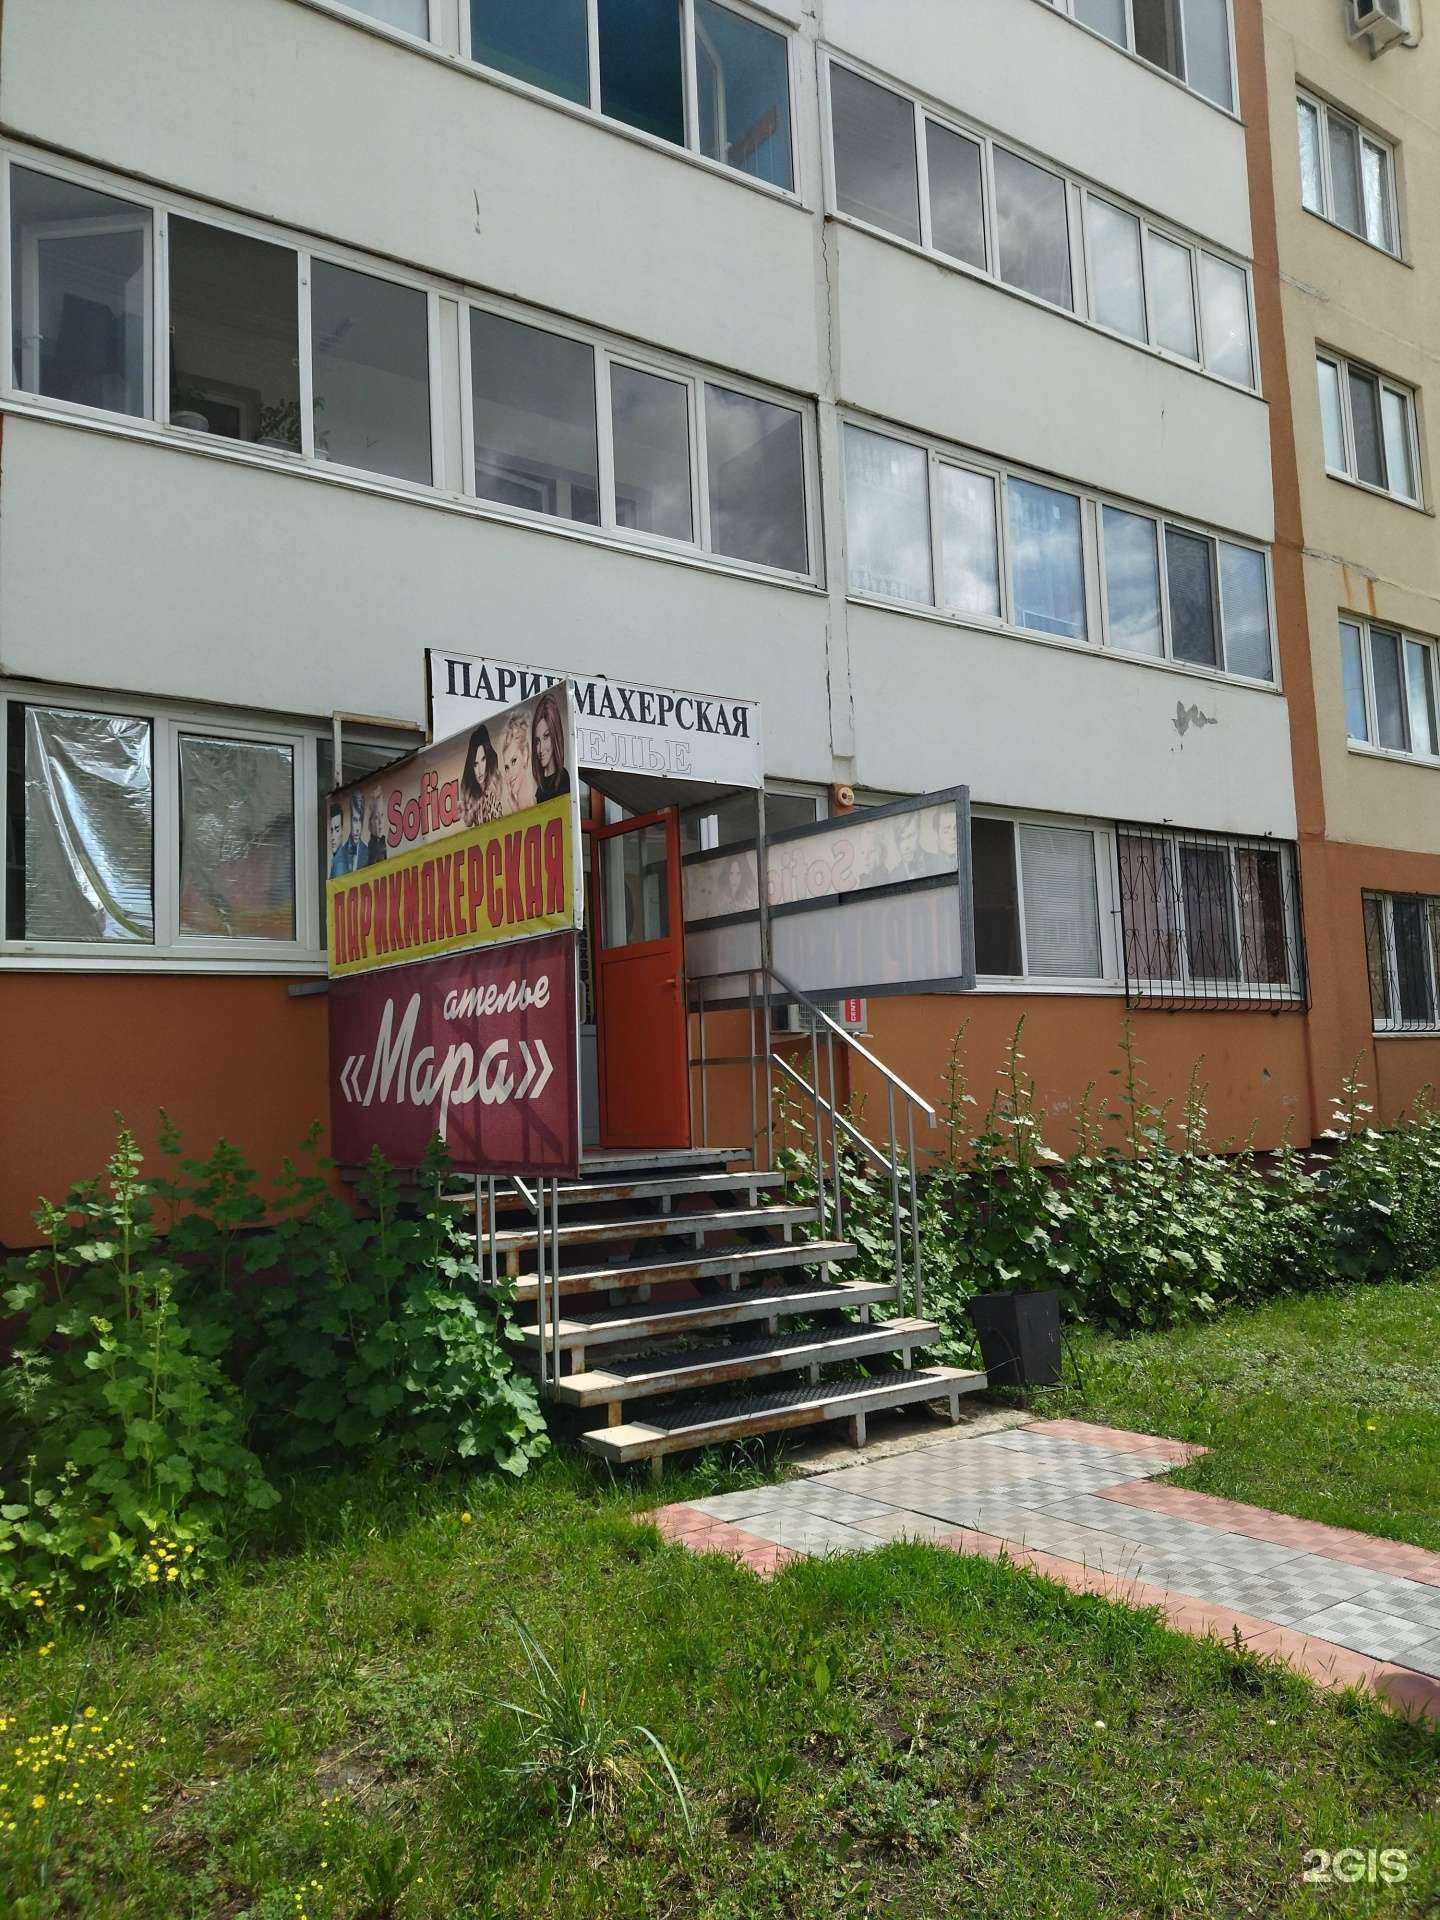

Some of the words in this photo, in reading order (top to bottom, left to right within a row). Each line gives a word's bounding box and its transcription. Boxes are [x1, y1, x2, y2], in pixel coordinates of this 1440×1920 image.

[443, 658, 750, 739] ПАРИМАХЕРСКАЯ
[577, 727, 692, 776] ЕЛЬЕ
[386, 770, 461, 849] Sofia
[334, 816, 565, 966] ПАРИКМАХЕРСКАЯ
[443, 975, 550, 1021] ателье
